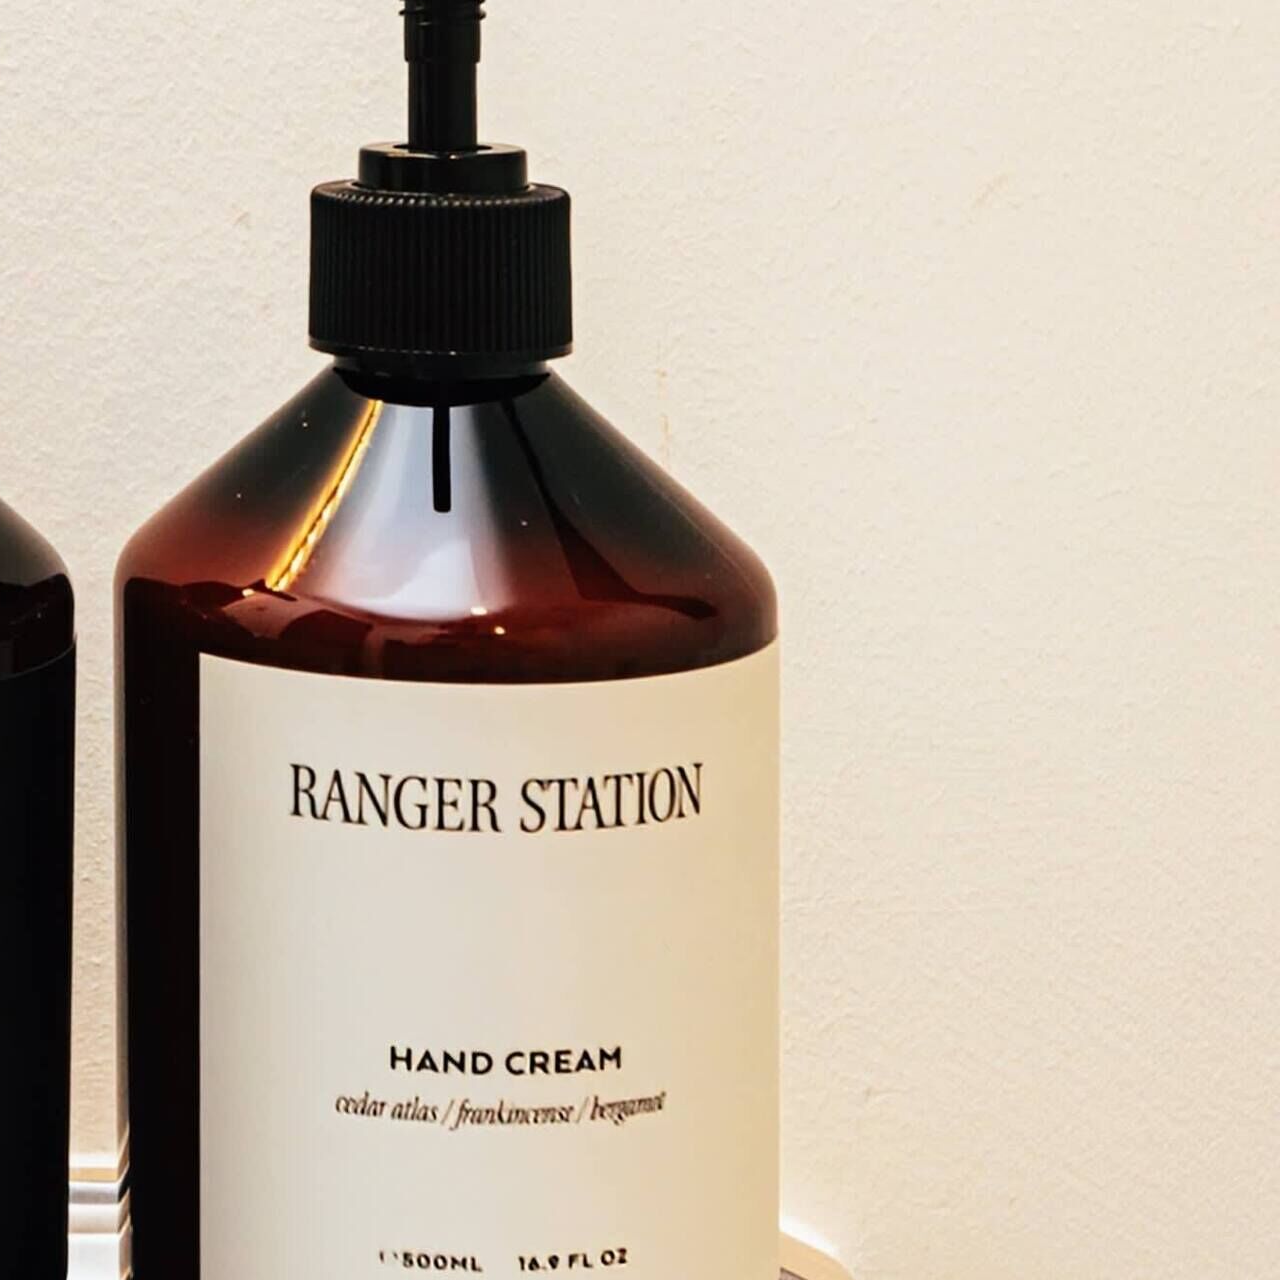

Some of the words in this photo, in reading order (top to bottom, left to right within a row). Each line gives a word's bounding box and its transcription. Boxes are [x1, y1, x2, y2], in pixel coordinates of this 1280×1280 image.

[289, 762, 503, 834] RANGER
[519, 761, 704, 834] STATION
[389, 1044, 494, 1076] HAND
[504, 1045, 622, 1077] CREAM
[335, 1090, 387, 1118] cedar
[390, 1095, 439, 1123] atlas
[449, 1098, 575, 1132] frankincense
[589, 1090, 667, 1127] bergamot
[517, 1254, 560, 1272] 16.9
[567, 1252, 594, 1270] FL
[599, 1247, 628, 1267] OZ
